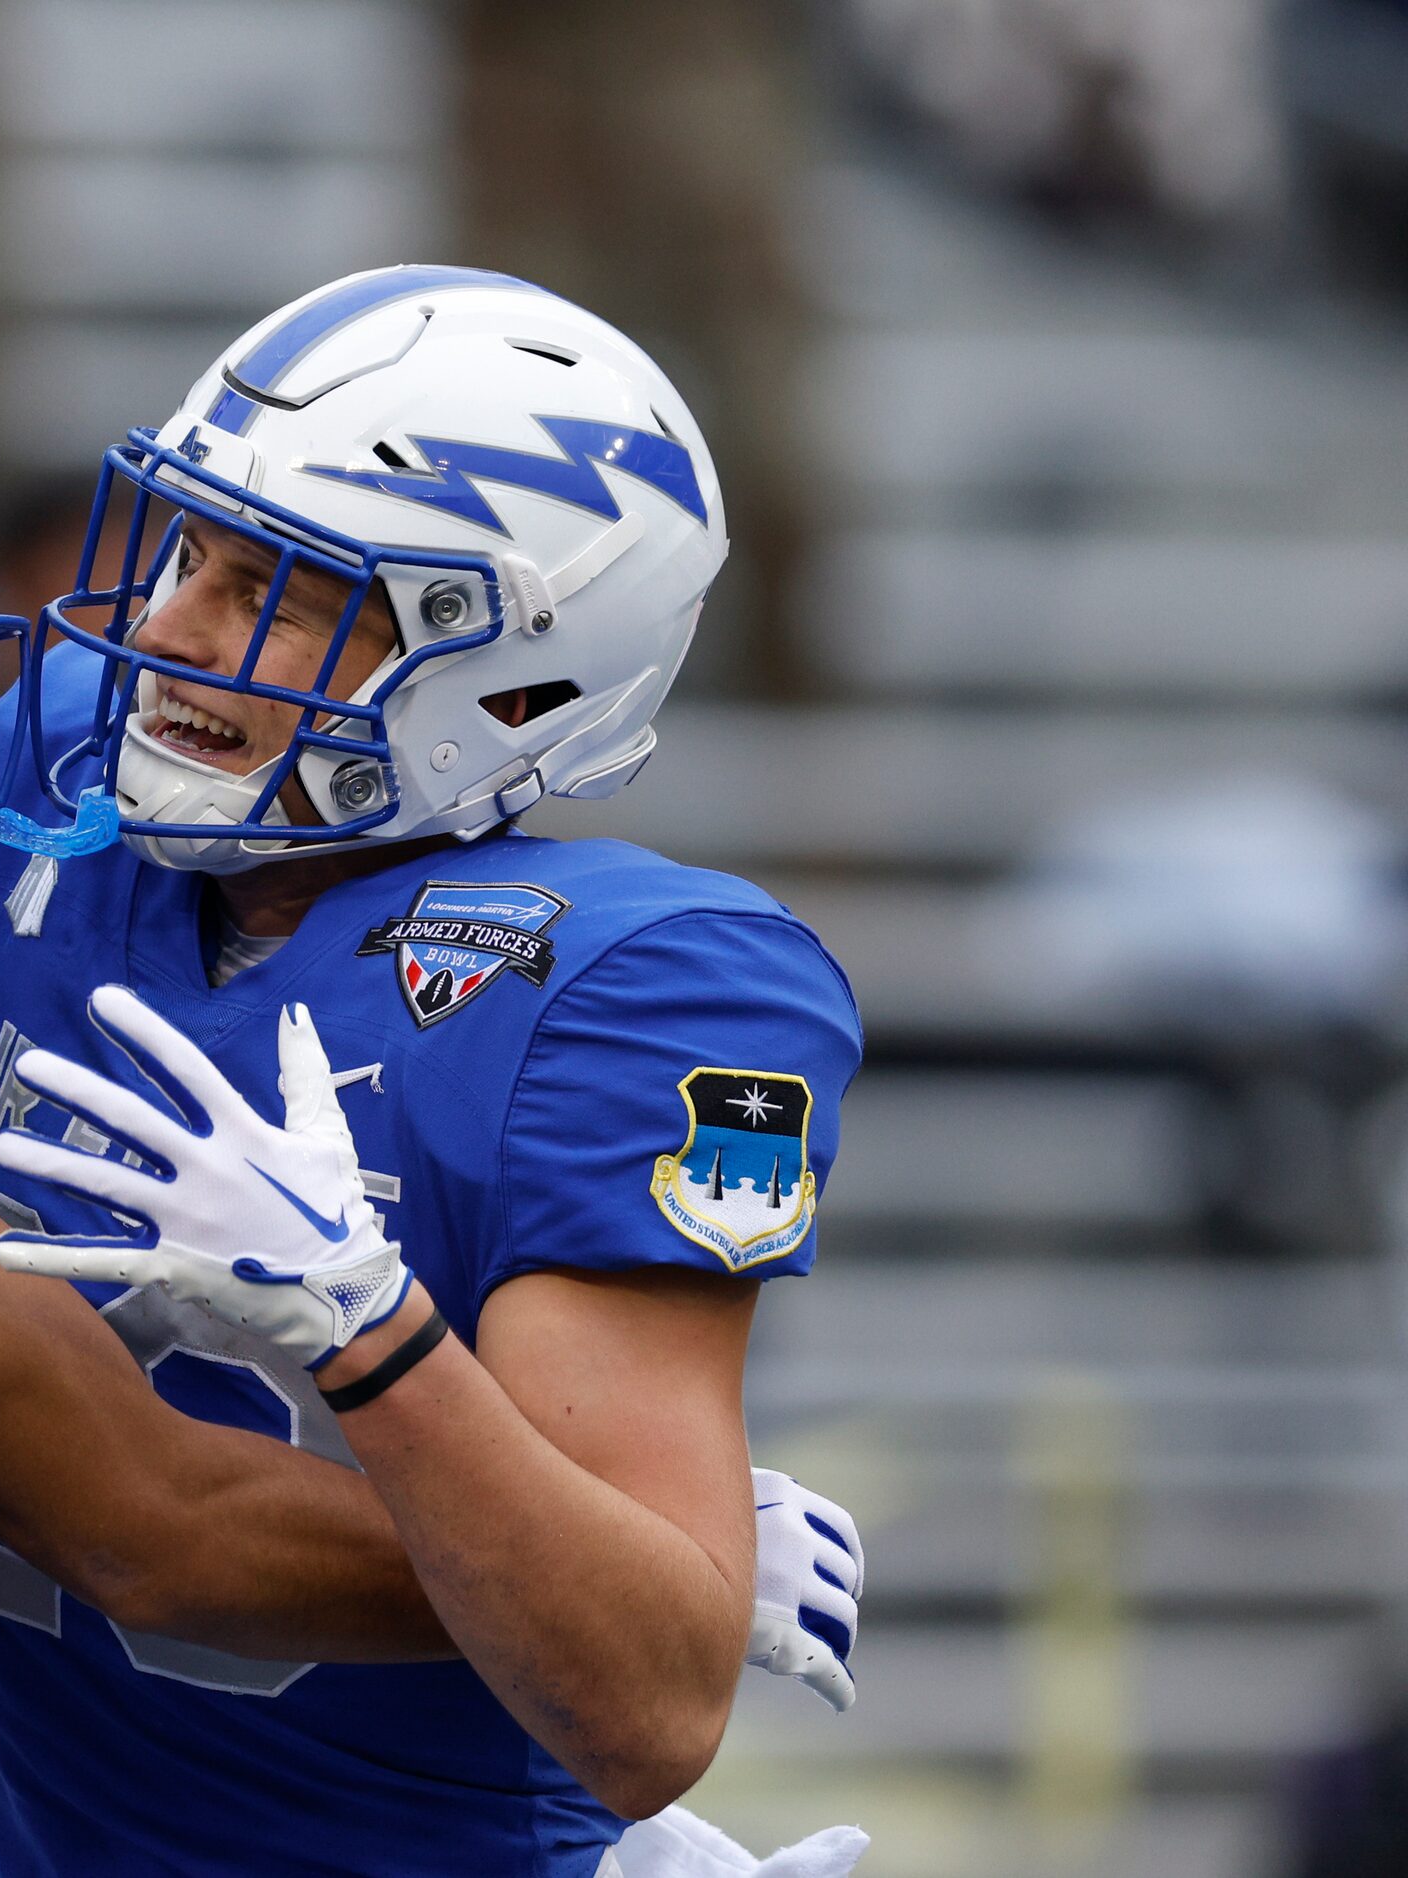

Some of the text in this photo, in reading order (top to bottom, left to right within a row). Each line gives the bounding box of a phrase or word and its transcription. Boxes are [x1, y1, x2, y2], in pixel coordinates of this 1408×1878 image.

[518, 569, 539, 616] Riddell
[475, 905, 514, 916] MARTIN
[386, 921, 541, 960] ARMED FORCES
[423, 947, 478, 969] BOWL
[664, 1191, 697, 1229] UNITED
[696, 1223, 731, 1251] STATES
[727, 1246, 741, 1267] AIR
[743, 1241, 776, 1263] FORCE
